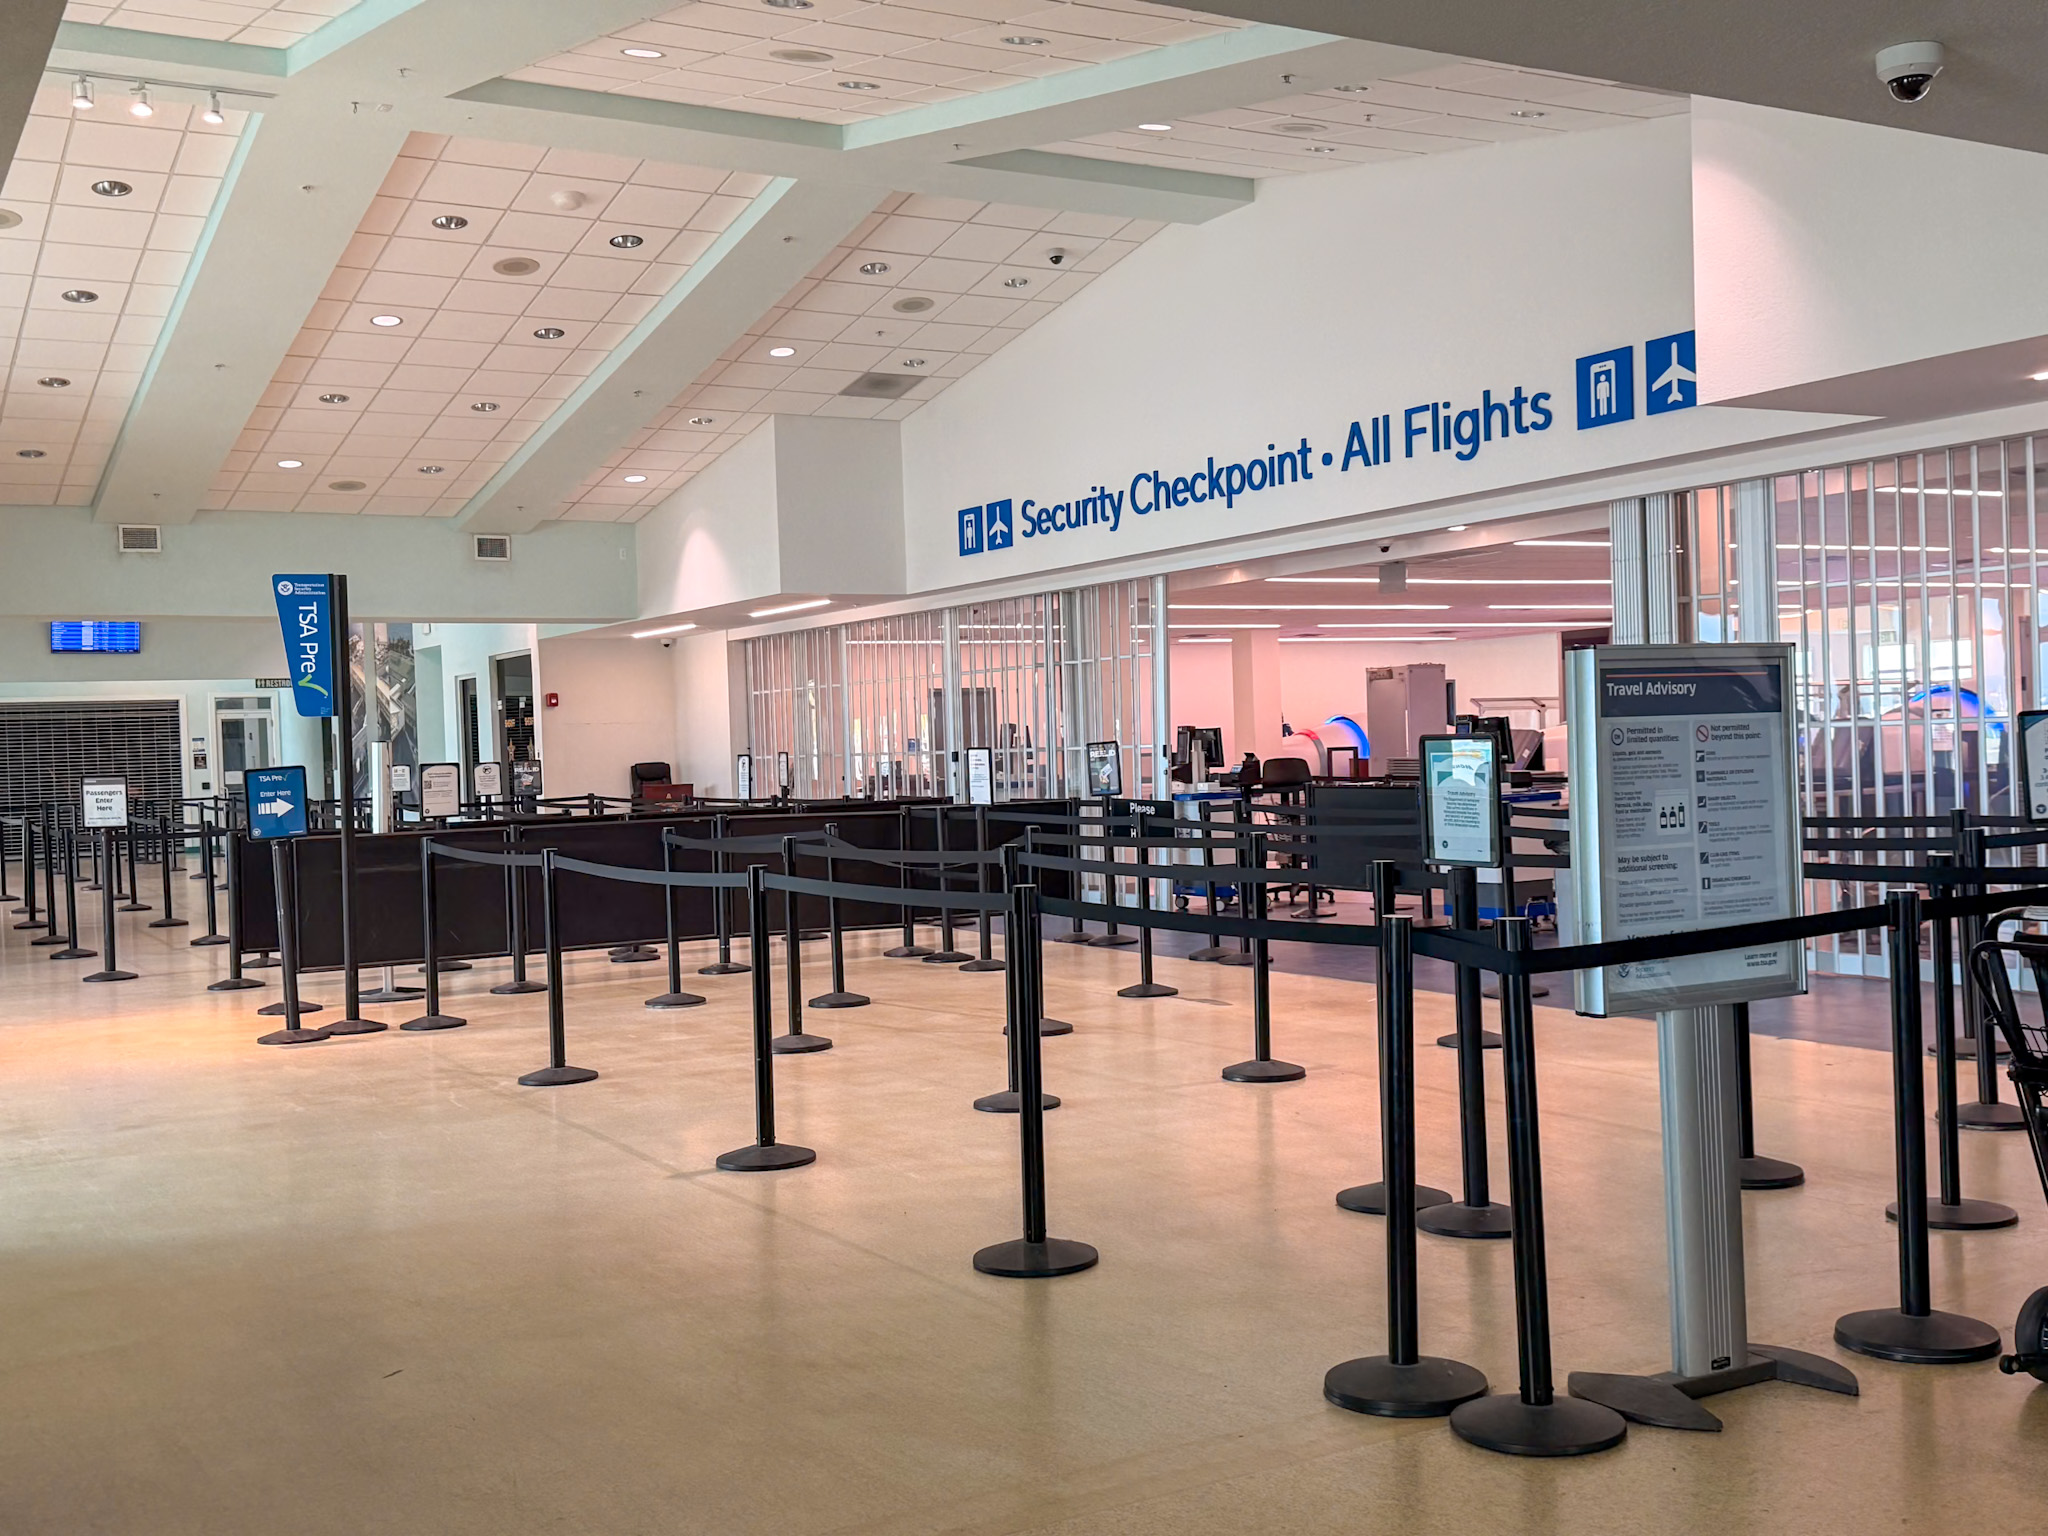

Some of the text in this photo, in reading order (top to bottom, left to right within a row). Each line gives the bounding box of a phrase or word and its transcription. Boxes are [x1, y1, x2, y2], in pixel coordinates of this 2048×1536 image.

[1021, 386, 1553, 538] Security Checkpoint All Flights
[298, 601, 319, 673] TSA Pre
[1606, 681, 1697, 697] Travel Advisory
[1626, 727, 1656, 735] Permitted
[1722, 724, 1750, 732] permitted
[1626, 735, 1648, 743] limited
[1711, 733, 1733, 741] beyond
[260, 789, 292, 798] Enter Here
[1129, 802, 1156, 815] Please
[1617, 856, 1630, 864] May
[1640, 854, 1662, 863] subject
[1662, 853, 1669, 861] to
[1617, 864, 1648, 872] additional
